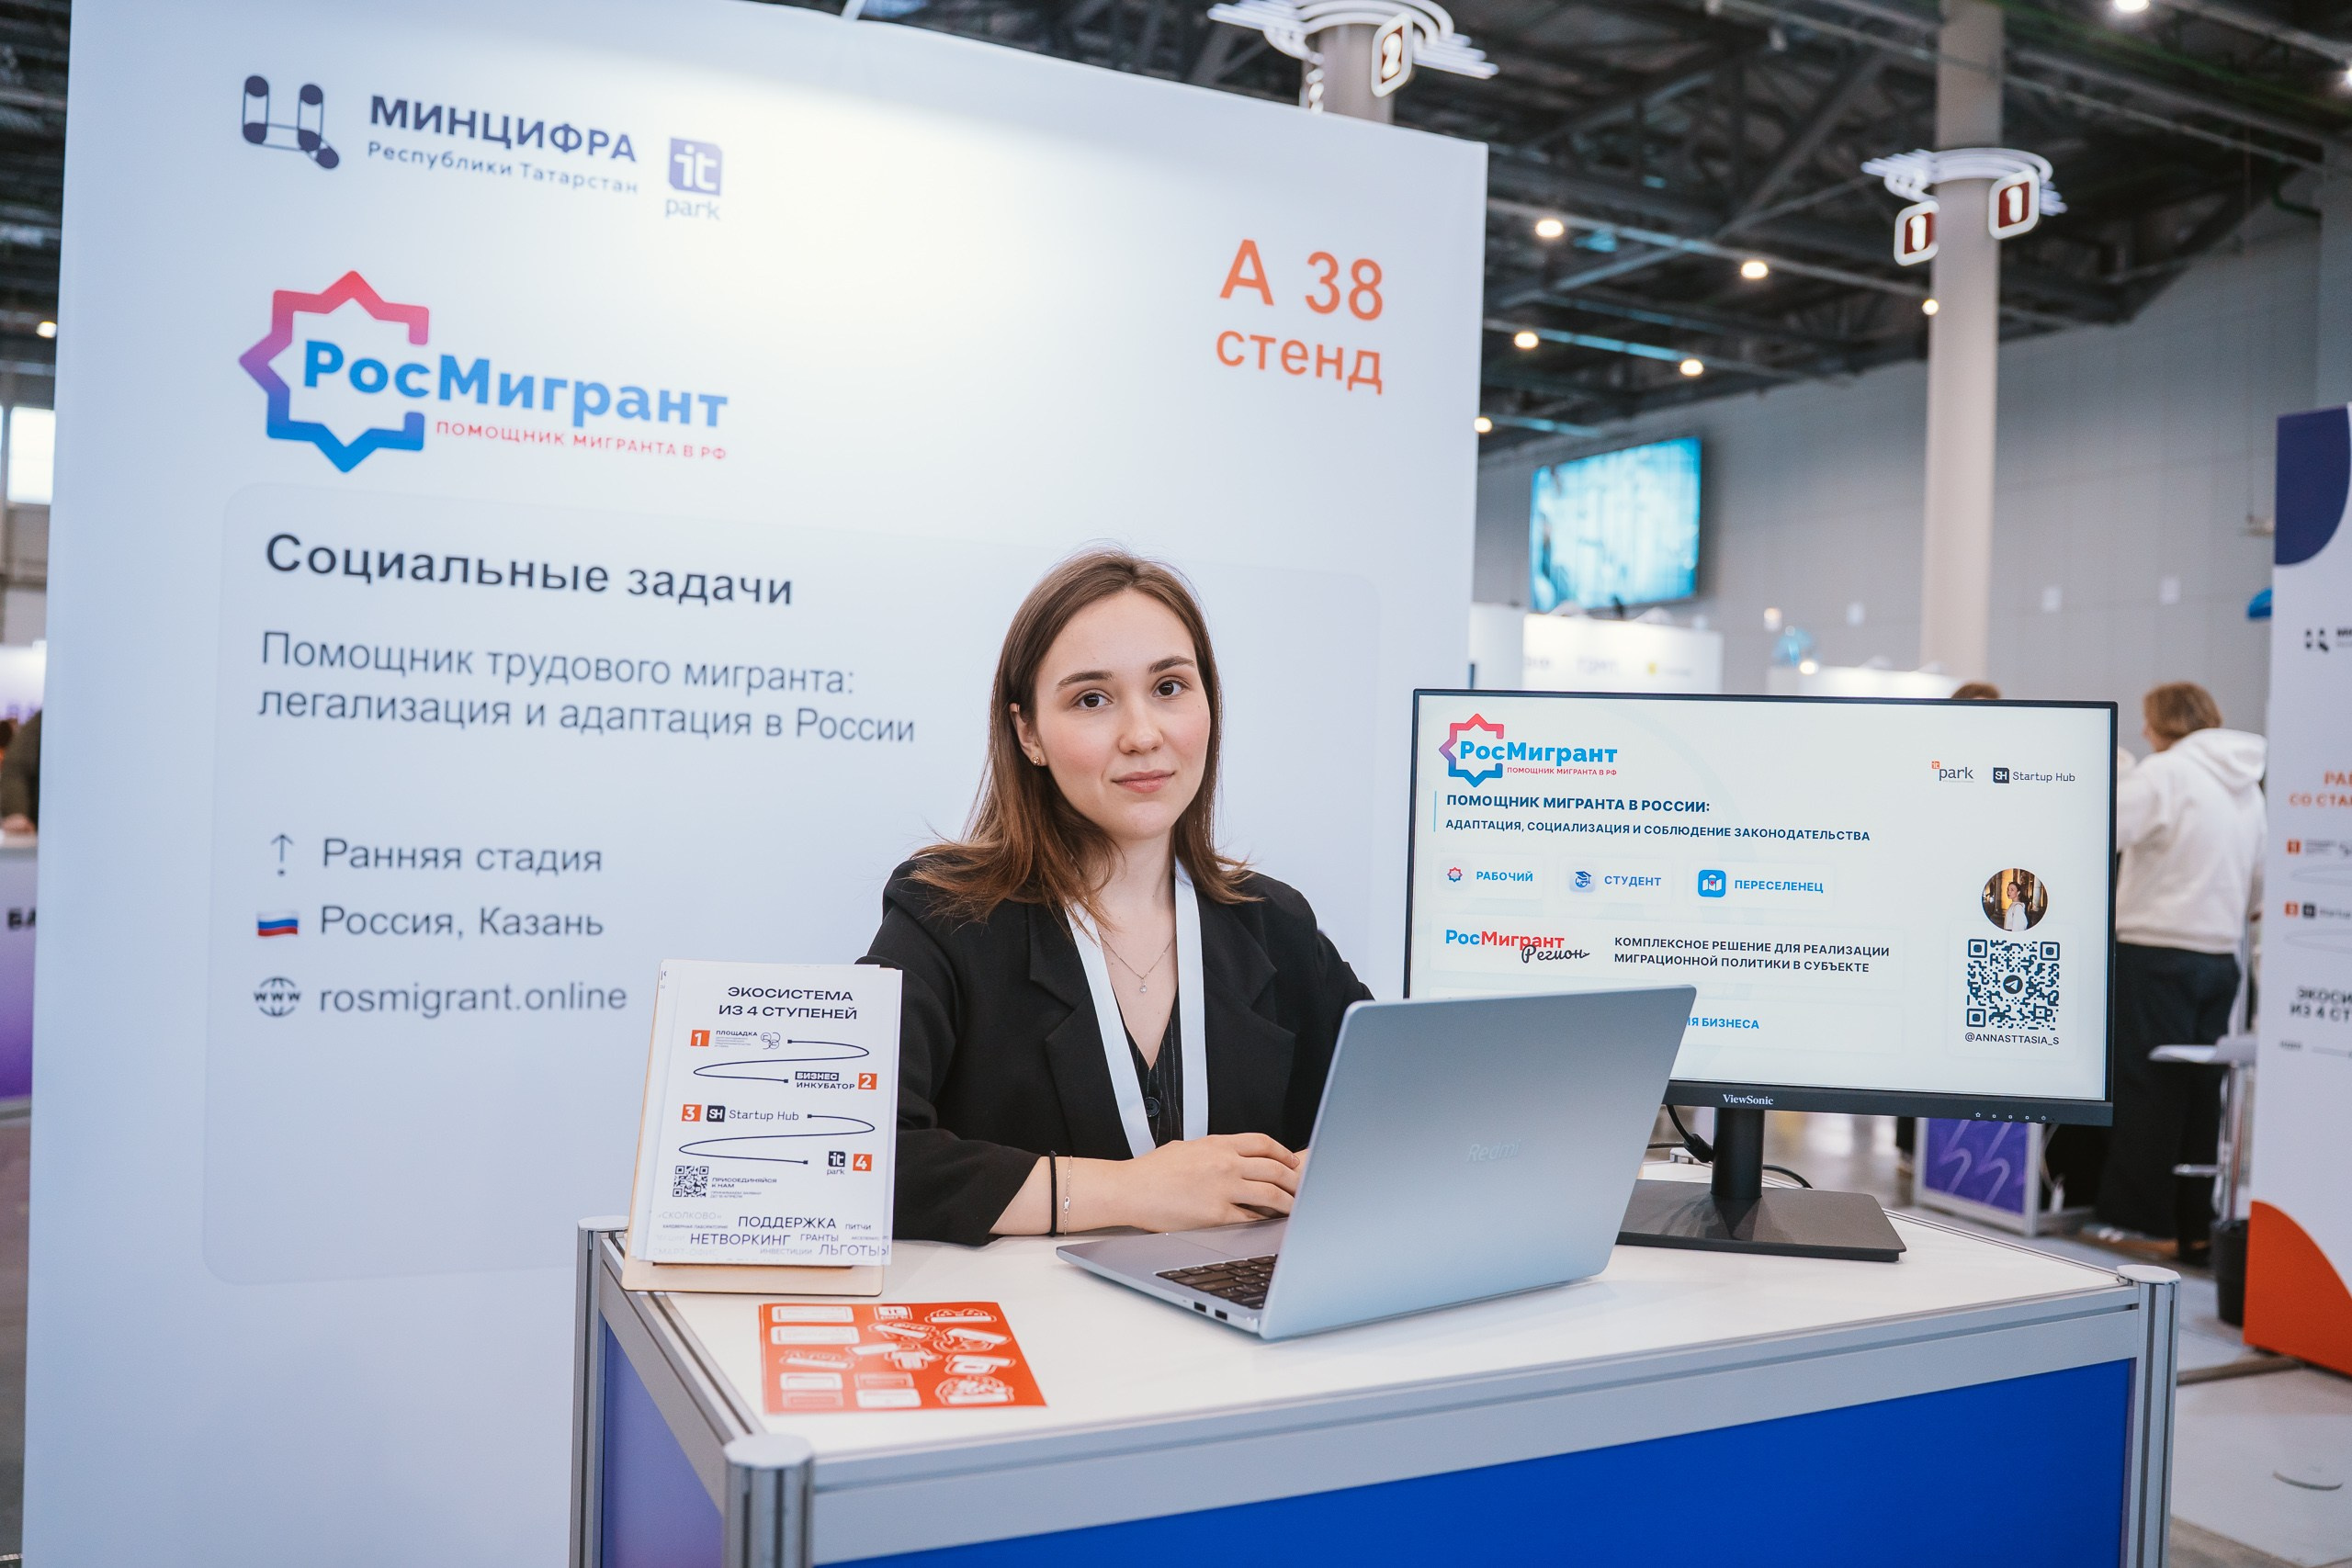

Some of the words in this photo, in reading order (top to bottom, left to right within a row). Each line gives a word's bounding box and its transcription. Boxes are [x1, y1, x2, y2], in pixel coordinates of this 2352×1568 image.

[369, 94, 638, 164] МИНЦИФРА
[368, 141, 513, 177] Республики
[520, 162, 639, 195] Татарстан
[673, 143, 717, 192] it
[664, 197, 721, 220] park
[2006, 186, 2023, 223] 1
[1910, 214, 1927, 252] 1
[1305, 250, 1385, 321] 38
[1216, 329, 1384, 396] стенд
[303, 339, 729, 428] РосМигрант
[436, 421, 564, 446] ПОМОЩНИК
[572, 434, 676, 457] МИГРАНТА
[684, 444, 694, 457] В
[700, 446, 727, 461] РФ
[266, 533, 610, 595] Социальные
[628, 563, 794, 606] задачи
[261, 631, 473, 676] Помощник
[487, 647, 672, 689] трудового
[684, 660, 854, 696] мигранта:
[258, 688, 511, 729] легализация
[526, 702, 546, 728] и
[560, 704, 752, 738] адаптация
[766, 714, 783, 737] в
[796, 707, 916, 744] России
[1460, 740, 1618, 767] РосМигрант
[1507, 766, 1555, 775] ПОМОЩНИК
[1556, 768, 1598, 776] МИГРАНТА
[1606, 769, 1617, 777] РФ
[1939, 766, 1974, 782] park
[1995, 771, 2007, 781] SH
[2012, 771, 2052, 783] Startup
[2055, 773, 2075, 782] Hub
[1446, 794, 1539, 809] ПОМОЩНИК
[1544, 796, 1625, 810] МИГРАНТА
[1628, 799, 1638, 811] В
[1641, 799, 1710, 813] РОССИИ:
[2315, 793, 2352, 808] СТА
[1445, 818, 1525, 833] АДАПТАЦИЯ,
[1527, 821, 1630, 835] СОЦИАЛИЗАЦИЯ
[1633, 824, 1641, 834] И
[1644, 825, 1731, 838] СОБЛЮДЕНИЕ
[1734, 828, 1871, 841] ЗАКОНОДАТЕЛЬСТВА
[322, 837, 461, 871] Ранняя
[475, 845, 603, 875] стадия
[1476, 870, 1533, 882] РАБОЧИЙ
[1604, 875, 1661, 887] СТУДЕНТ
[1734, 879, 1824, 894] ПЕРЕСЕЛЕНЕЦ
[322, 906, 464, 940] Россия,
[480, 907, 604, 937] Казань
[1445, 929, 1565, 951] РосМигрант
[1614, 936, 1709, 950] КОМПЛЕКСНОЕ
[1712, 941, 1771, 953] РЕШЕНИЕ
[1774, 942, 1801, 954] ДЛЯ
[1804, 944, 1890, 958] РЕАЛИЗАЦИИ
[1521, 943, 1590, 964] Регион
[1614, 953, 1718, 967] МИГРАЦИОННОЙ
[1721, 957, 1791, 970] ПОЛИТИКИ
[1793, 960, 1801, 970] В
[1804, 961, 1870, 974] СУБЪЕКТЕ
[321, 980, 628, 1019] rosmigrant.online
[727, 987, 854, 1001] ЭКОСИСТЕМА
[718, 1005, 743, 1016] ИЗ
[746, 1006, 759, 1017] 4
[762, 1006, 857, 1021] СТУПЕНЕЙ
[1702, 1017, 1759, 1030] БИЗНЕСА
[695, 1032, 703, 1047] 1
[1964, 1032, 2060, 1046] @ANNASTTASIA_S
[797, 1072, 838, 1081] БИЗНЕС
[861, 1074, 872, 1089] 2
[796, 1082, 855, 1090] ИНКУБАТОР
[1722, 1093, 1774, 1105] ViewSonic
[684, 1106, 695, 1121] 3
[708, 1109, 723, 1120] SH
[729, 1110, 774, 1122] Startup
[777, 1111, 799, 1121] Hub
[1466, 1138, 1521, 1162] Redmi
[830, 1153, 844, 1167] it
[854, 1156, 867, 1170] 4
[826, 1168, 845, 1177] park
[738, 1215, 837, 1230] ПОДДЕРЖКА
[844, 1223, 872, 1231] ПИТЧИ
[690, 1233, 791, 1246] НЕТВОРКИНГ
[800, 1234, 840, 1242] ГРАНТЫ
[760, 1247, 813, 1256] ИНВЕСТИЦИИ
[819, 1244, 880, 1258] ЛЬГОТЫ
